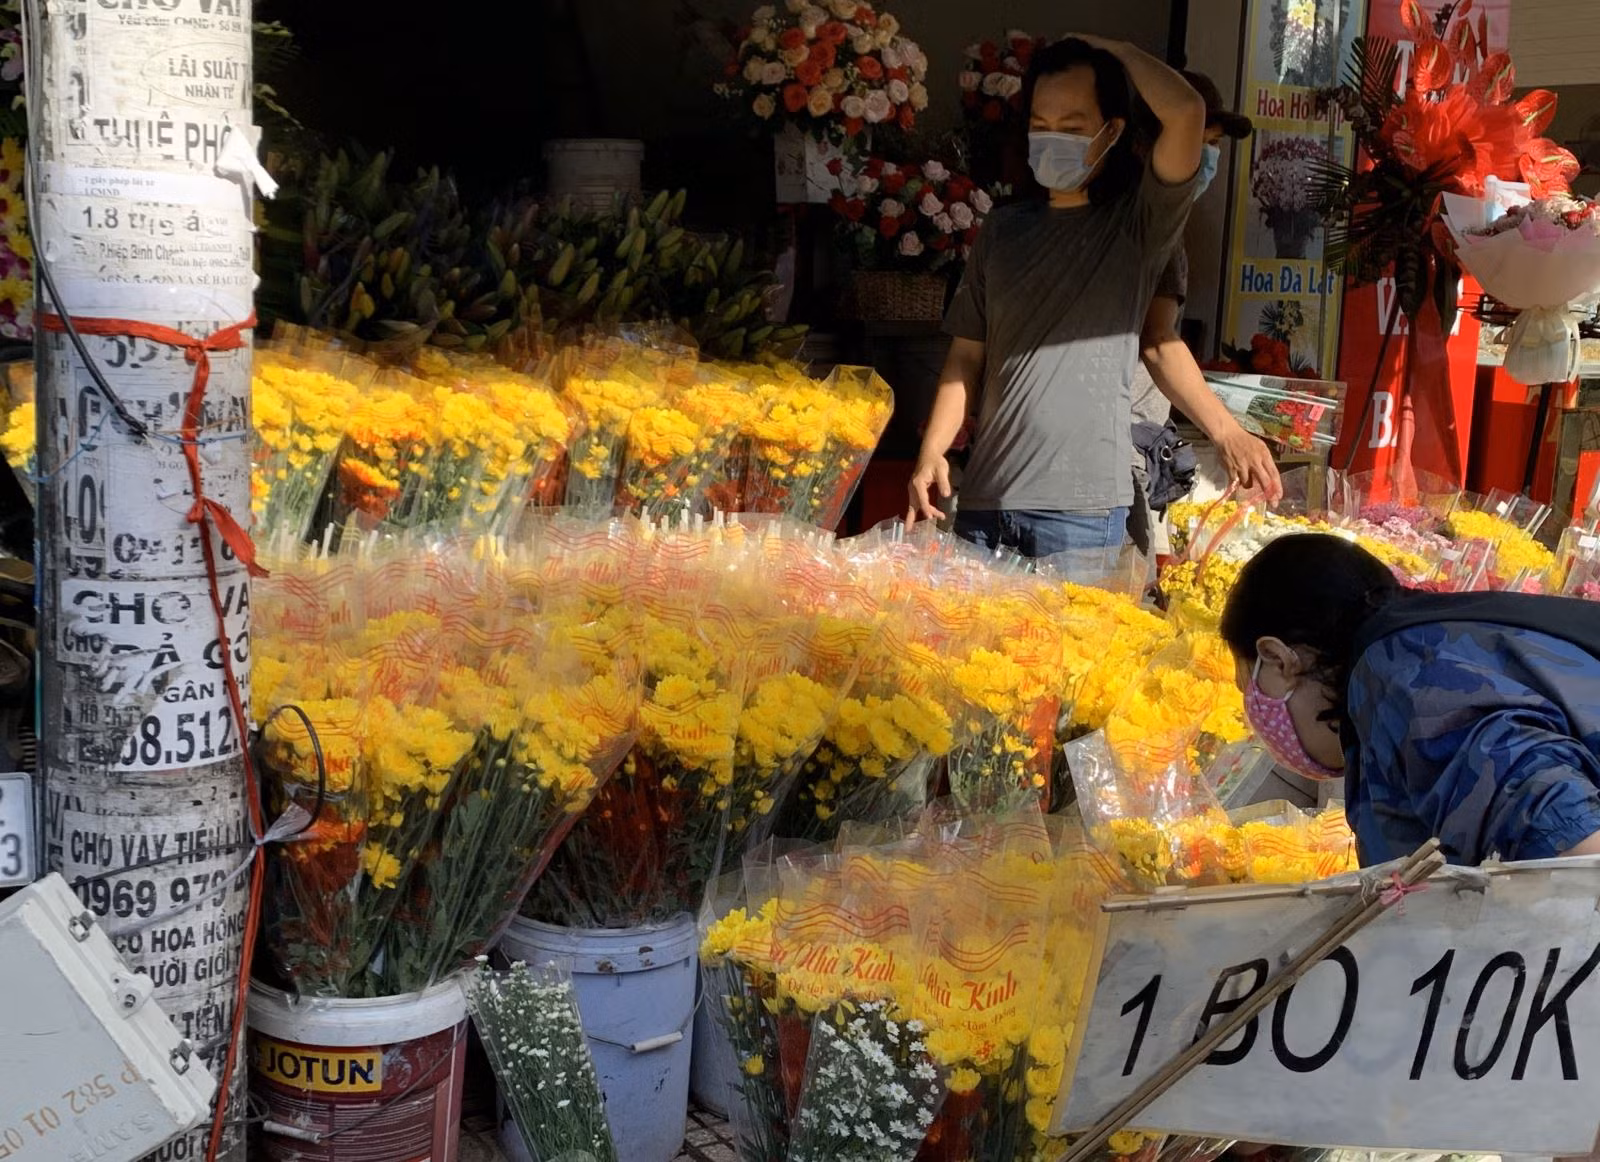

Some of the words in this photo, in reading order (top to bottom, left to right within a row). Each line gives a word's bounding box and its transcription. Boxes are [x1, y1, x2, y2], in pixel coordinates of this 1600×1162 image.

[1256, 87, 1285, 119] Hoa
[1240, 263, 1275, 293] Hoa
[151, 925, 196, 953] HOA
[959, 969, 1018, 1012] Kính
[1408, 941, 1600, 1082] 10K
[265, 1046, 374, 1085] JOTUN
